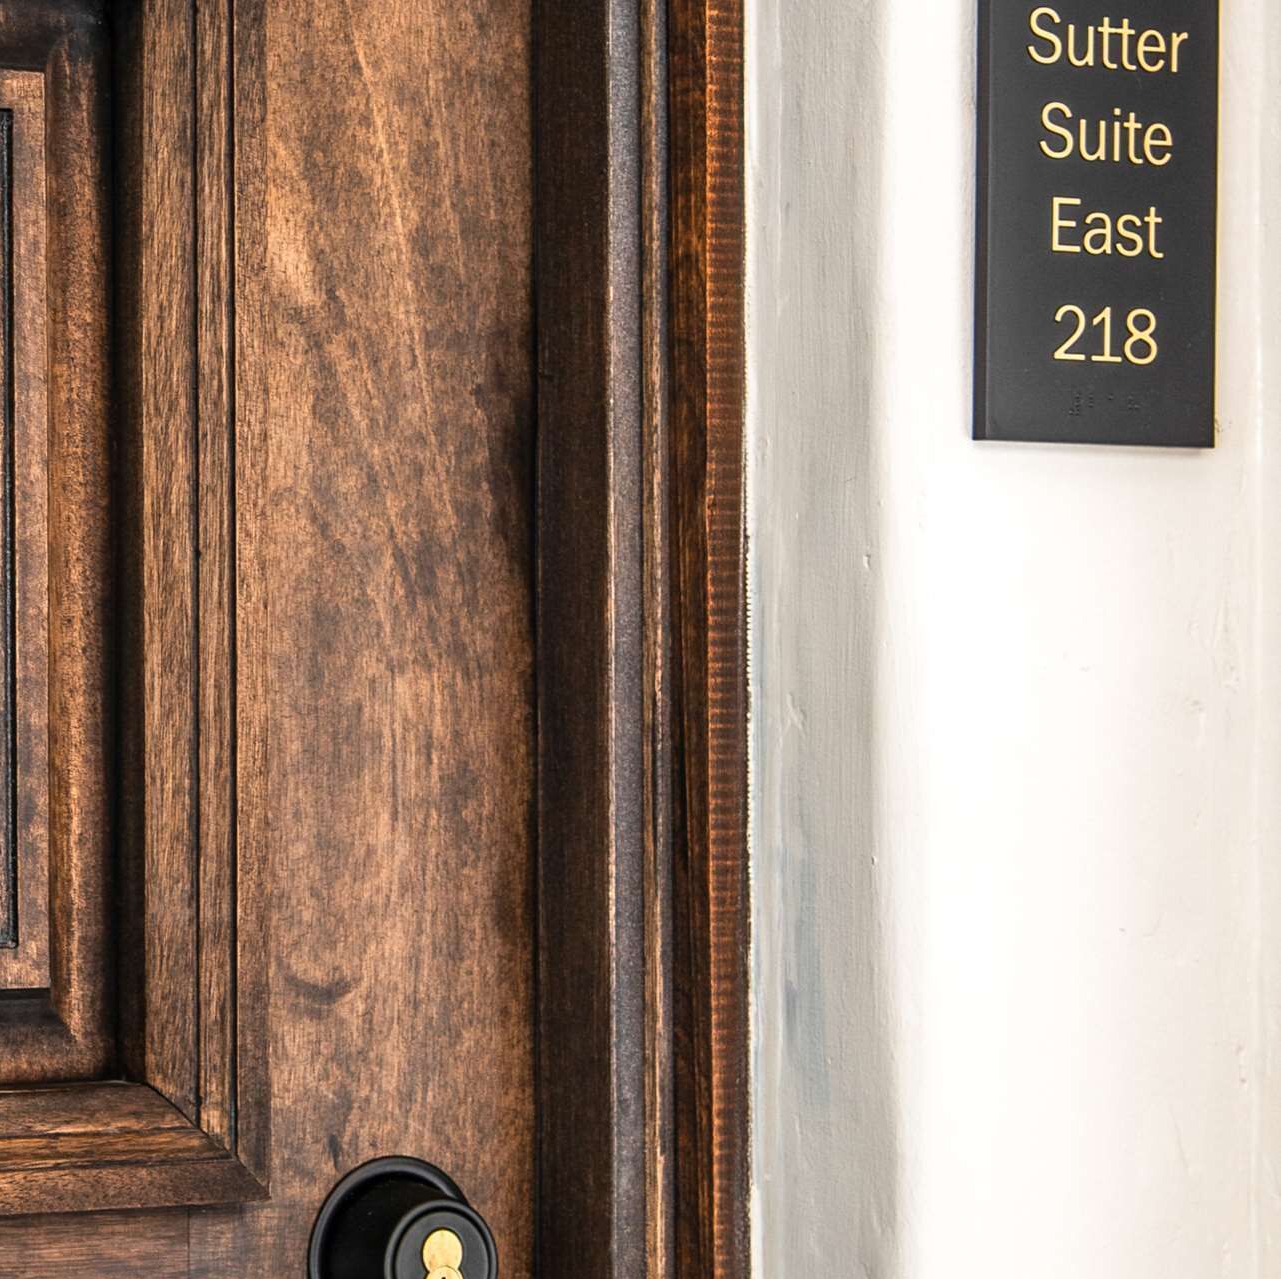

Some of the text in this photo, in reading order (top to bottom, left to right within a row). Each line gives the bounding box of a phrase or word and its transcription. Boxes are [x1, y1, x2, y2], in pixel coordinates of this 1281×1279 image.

[1027, 6, 1189, 73] Sutter
[1039, 100, 1174, 166] Suite
[1050, 196, 1165, 260] East
[1053, 304, 1159, 365] 218
